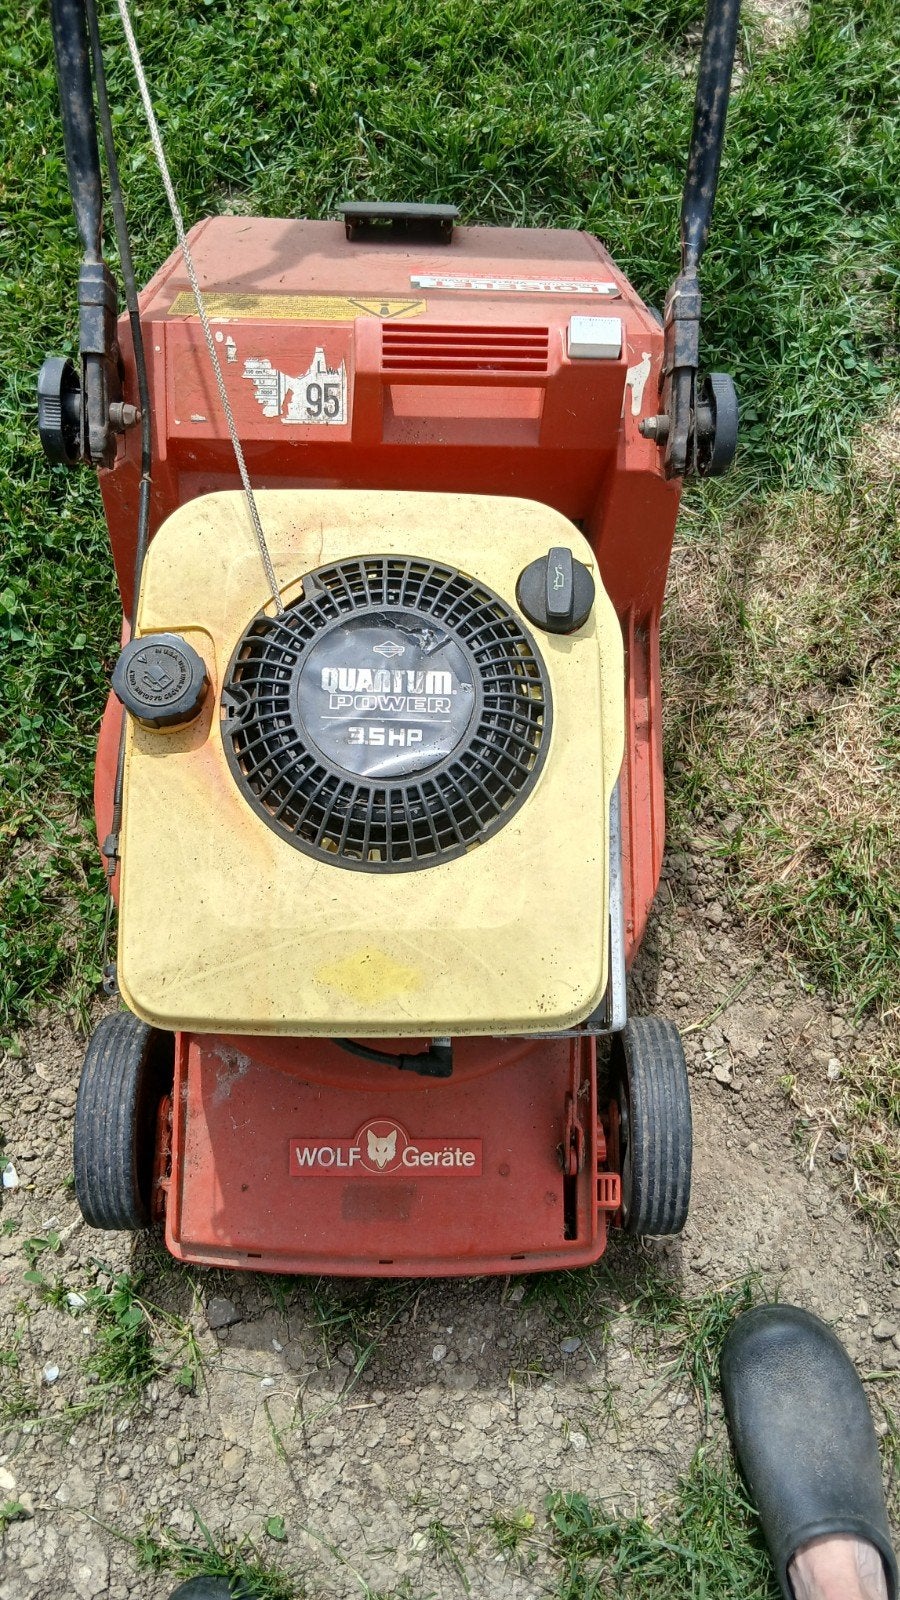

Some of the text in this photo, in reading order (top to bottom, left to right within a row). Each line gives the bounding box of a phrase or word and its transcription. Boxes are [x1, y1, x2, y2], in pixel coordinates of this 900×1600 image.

[306, 383, 340, 418] 95
[321, 667, 452, 695] QUANTUM
[329, 694, 451, 713] POWER
[296, 1145, 476, 1167] WOLF Geräte
